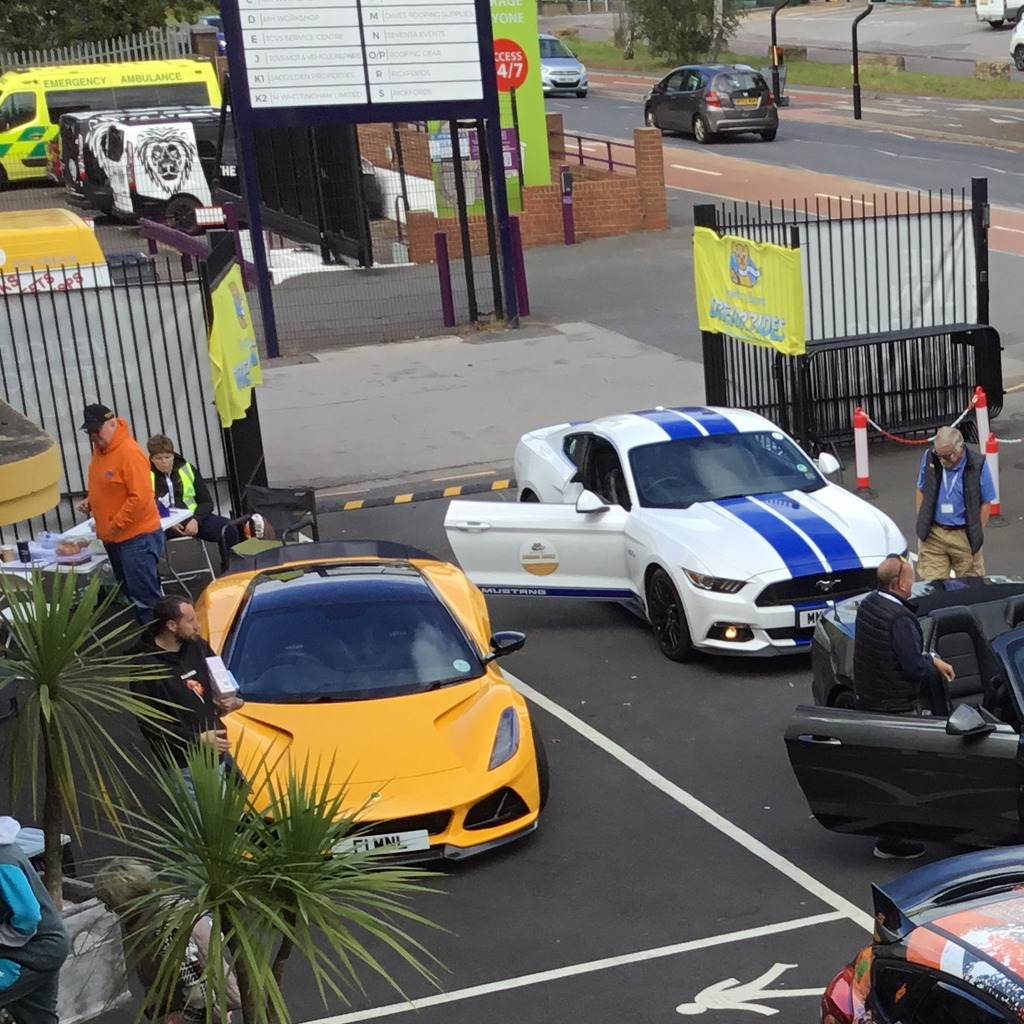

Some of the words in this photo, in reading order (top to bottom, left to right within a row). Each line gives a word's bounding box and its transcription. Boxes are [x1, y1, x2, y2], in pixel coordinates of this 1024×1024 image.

[248, 15, 256, 24] D
[277, 14, 321, 22] WORKSHOP
[409, 11, 440, 19] ROOFING
[442, 10, 474, 18] SUPPLIES
[251, 35, 258, 43] E
[284, 34, 315, 42] SERVICE
[316, 33, 344, 41] CENTRE
[254, 55, 260, 63] J
[254, 75, 265, 83] K1
[311, 72, 356, 80] PROPERTIES
[391, 69, 431, 77] PICKFORDS
[43, 76, 107, 89] EMERGENCY
[120, 72, 183, 84] AMBULANCE
[255, 94, 268, 103] K2
[334, 91, 362, 99] LIMITED
[378, 89, 385, 97] S
[220, 164, 237, 177] HE
[481, 587, 547, 595] MUSTANG
